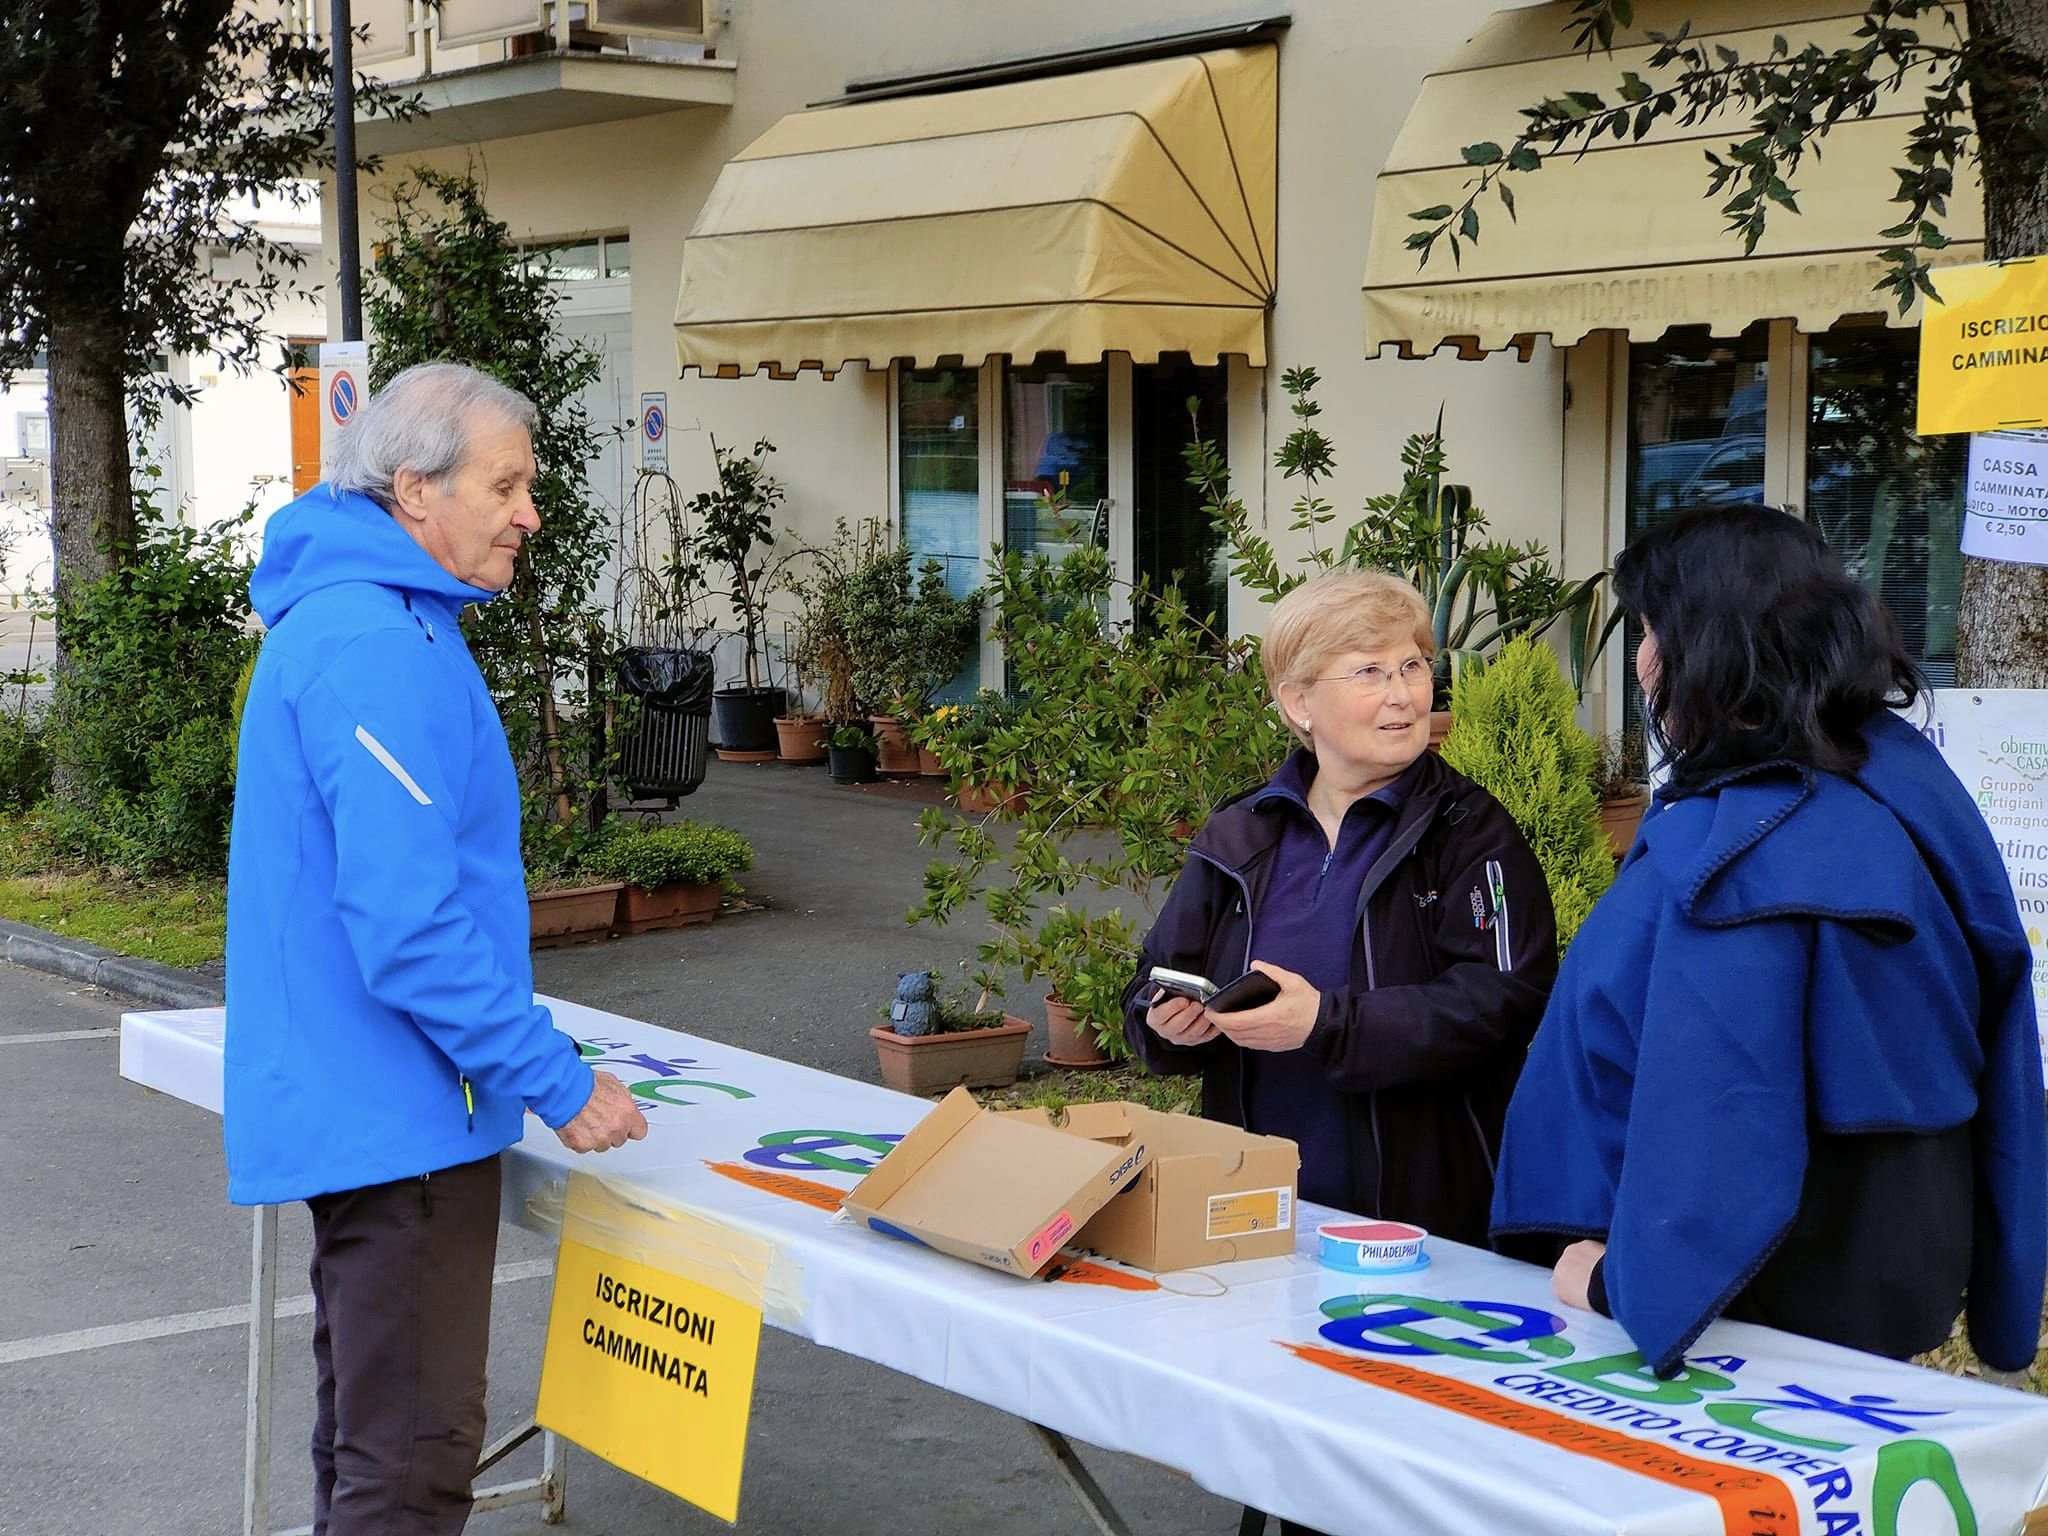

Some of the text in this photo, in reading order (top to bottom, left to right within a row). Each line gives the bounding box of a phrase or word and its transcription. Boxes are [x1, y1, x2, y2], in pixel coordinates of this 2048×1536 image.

[1517, 274, 1687, 330] PASTICCERIA
[1983, 458, 2038, 476] CASSA
[1996, 522, 2025, 536] 2,50
[2016, 756, 2048, 769] CASA
[1981, 775, 2034, 795] Gruppo
[1978, 790, 2043, 811] Artigiani
[2018, 898, 2048, 914] no
[1361, 1243, 1418, 1259] PHILADELPHIA
[595, 1272, 716, 1346] ISCRIZIONI
[583, 1318, 709, 1398] CAMMINATA
[1493, 1373, 1864, 1536] CREDITO COOPERA
